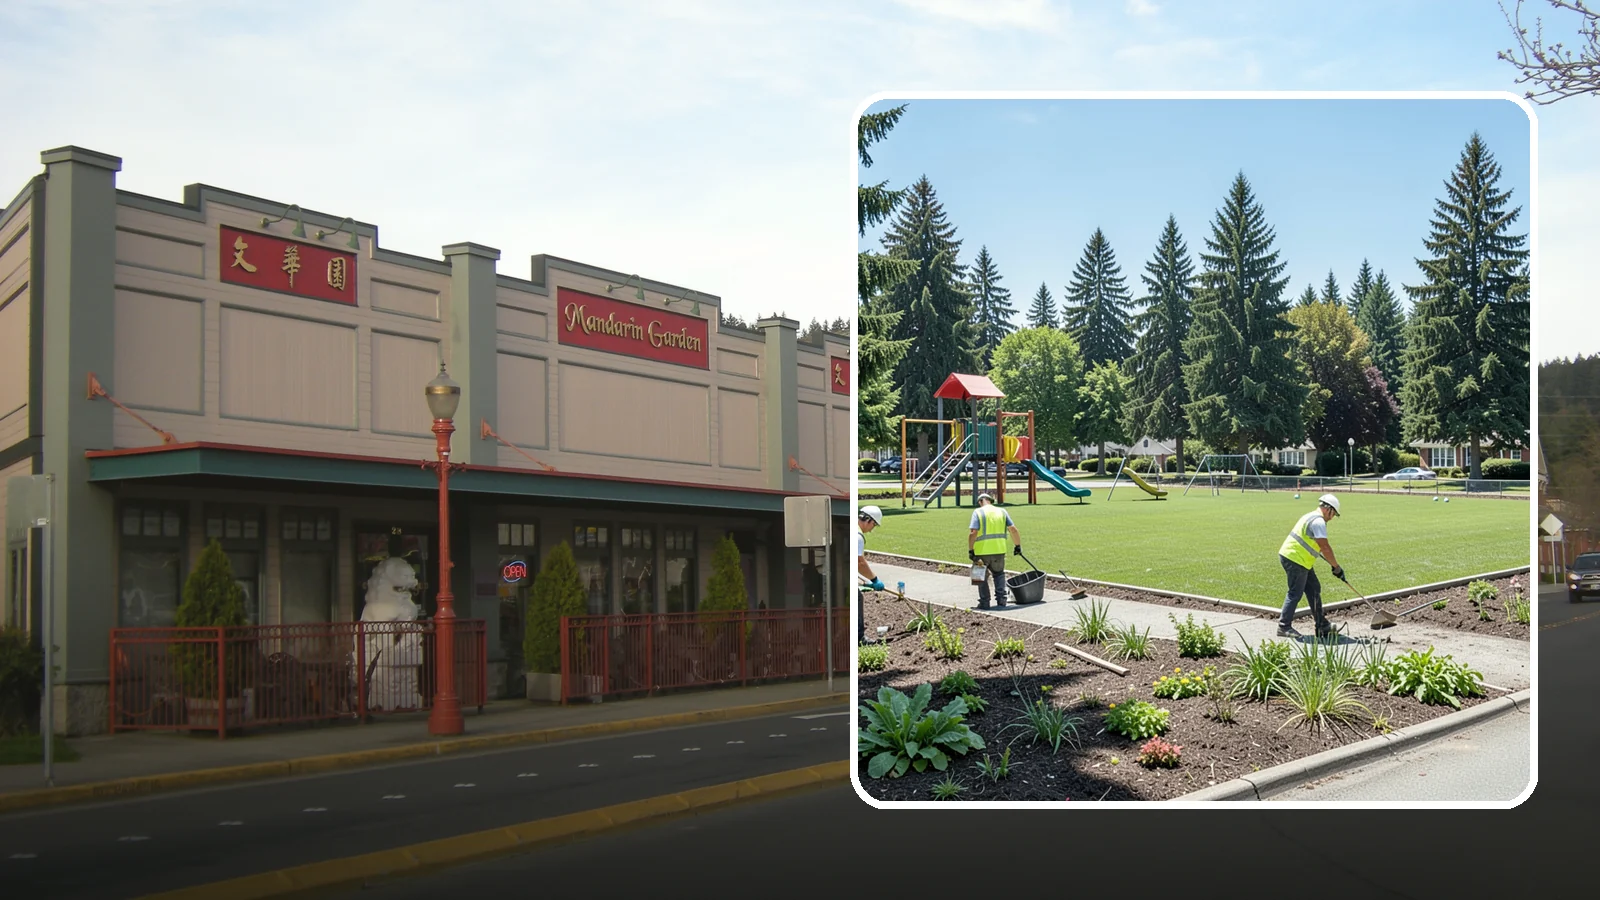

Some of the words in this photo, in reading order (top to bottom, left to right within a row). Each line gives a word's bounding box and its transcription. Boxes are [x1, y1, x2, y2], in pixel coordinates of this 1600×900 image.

[564, 302, 644, 341] Mandarin
[647, 320, 702, 352] Garden
[503, 565, 527, 577] OPEN
